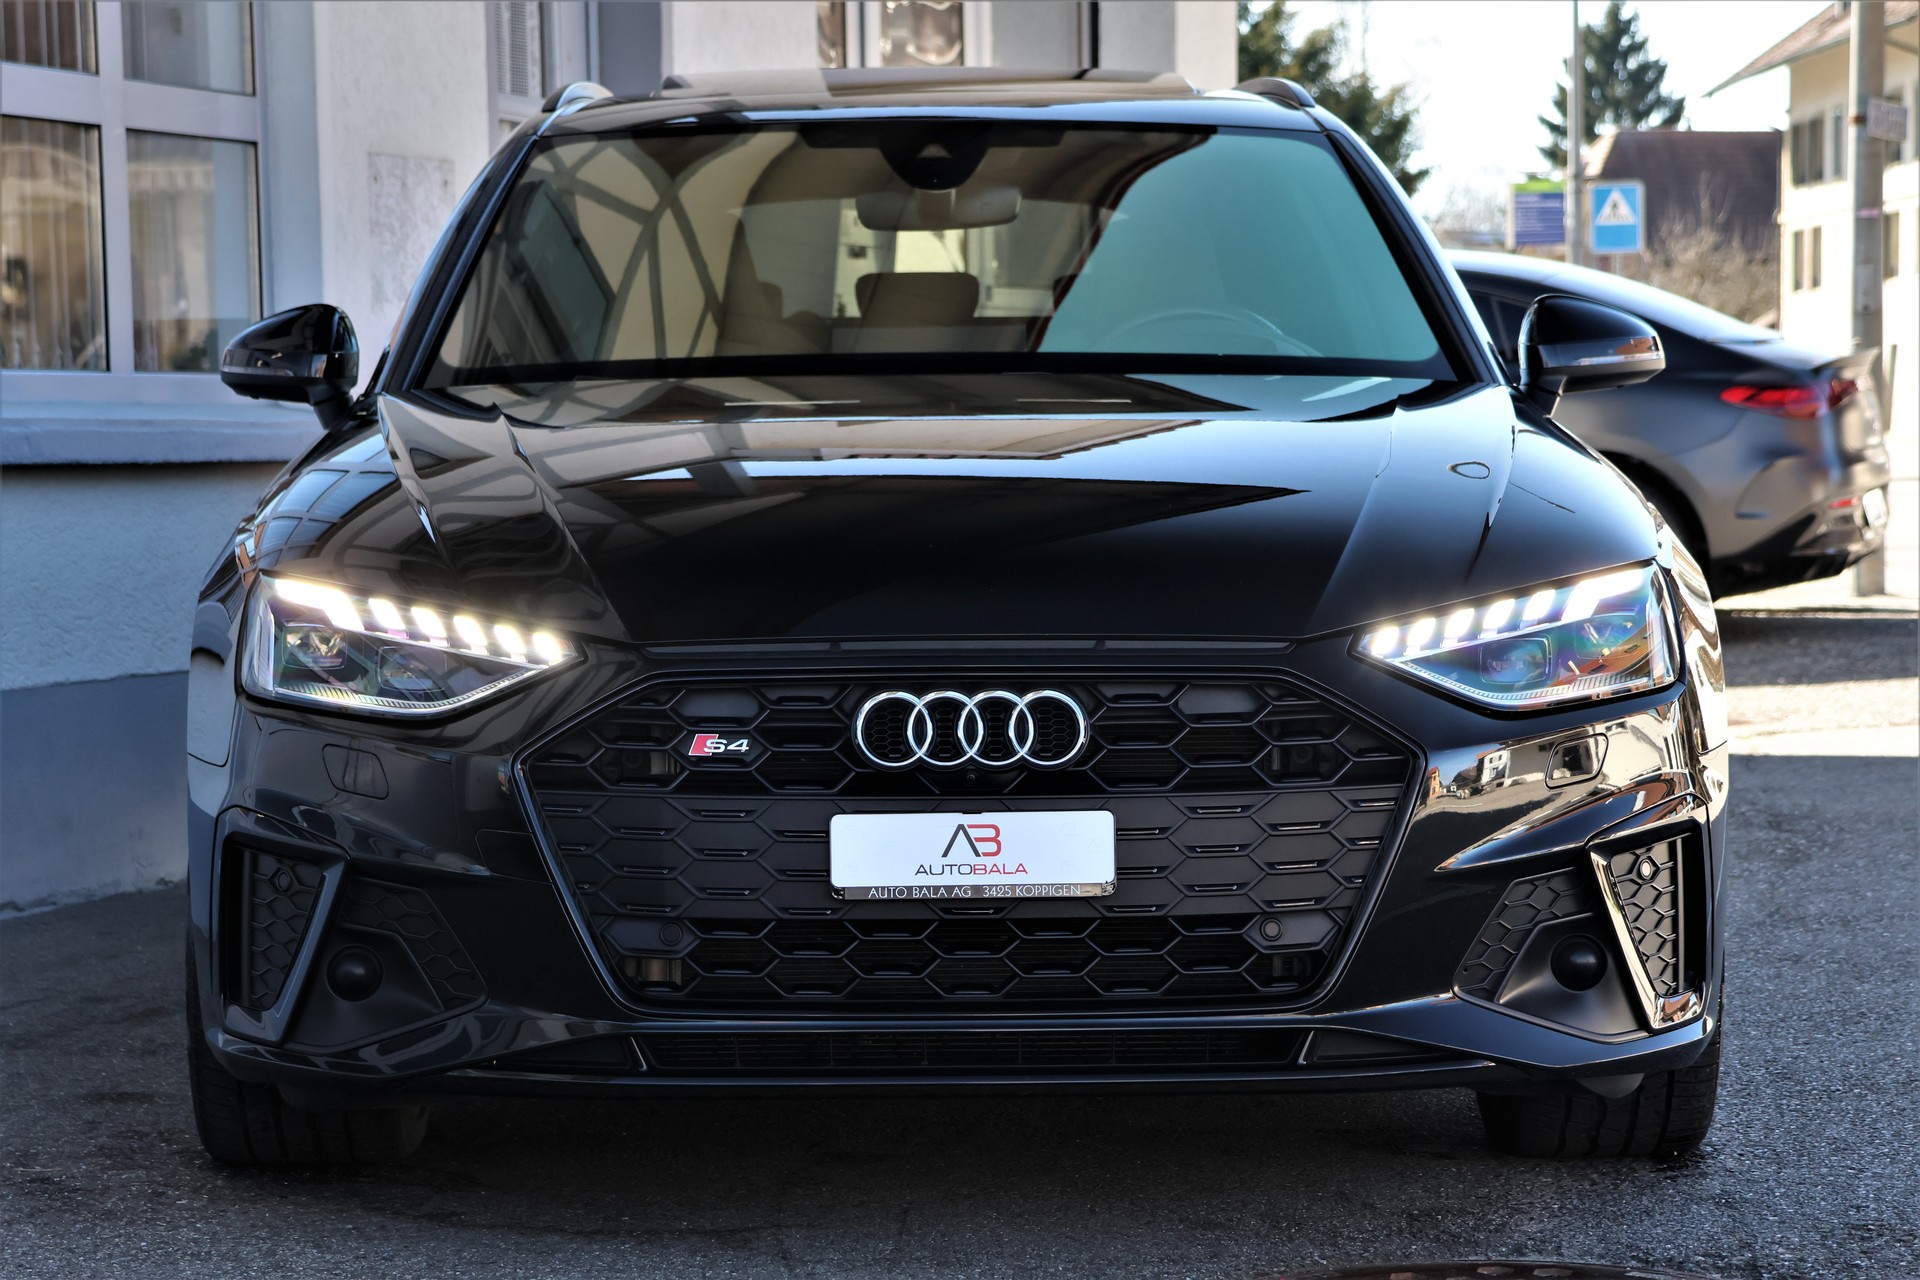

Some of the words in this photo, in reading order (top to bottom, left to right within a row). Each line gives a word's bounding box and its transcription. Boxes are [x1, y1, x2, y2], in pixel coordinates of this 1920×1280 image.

[703, 738, 749, 753] S4
[915, 863, 1028, 876] AUTOBALA
[868, 886, 907, 898] AUTO
[912, 886, 948, 898] BALA
[951, 885, 972, 898] AG
[982, 885, 1012, 897] 3425
[1015, 884, 1080, 897] KOPPIGEN
